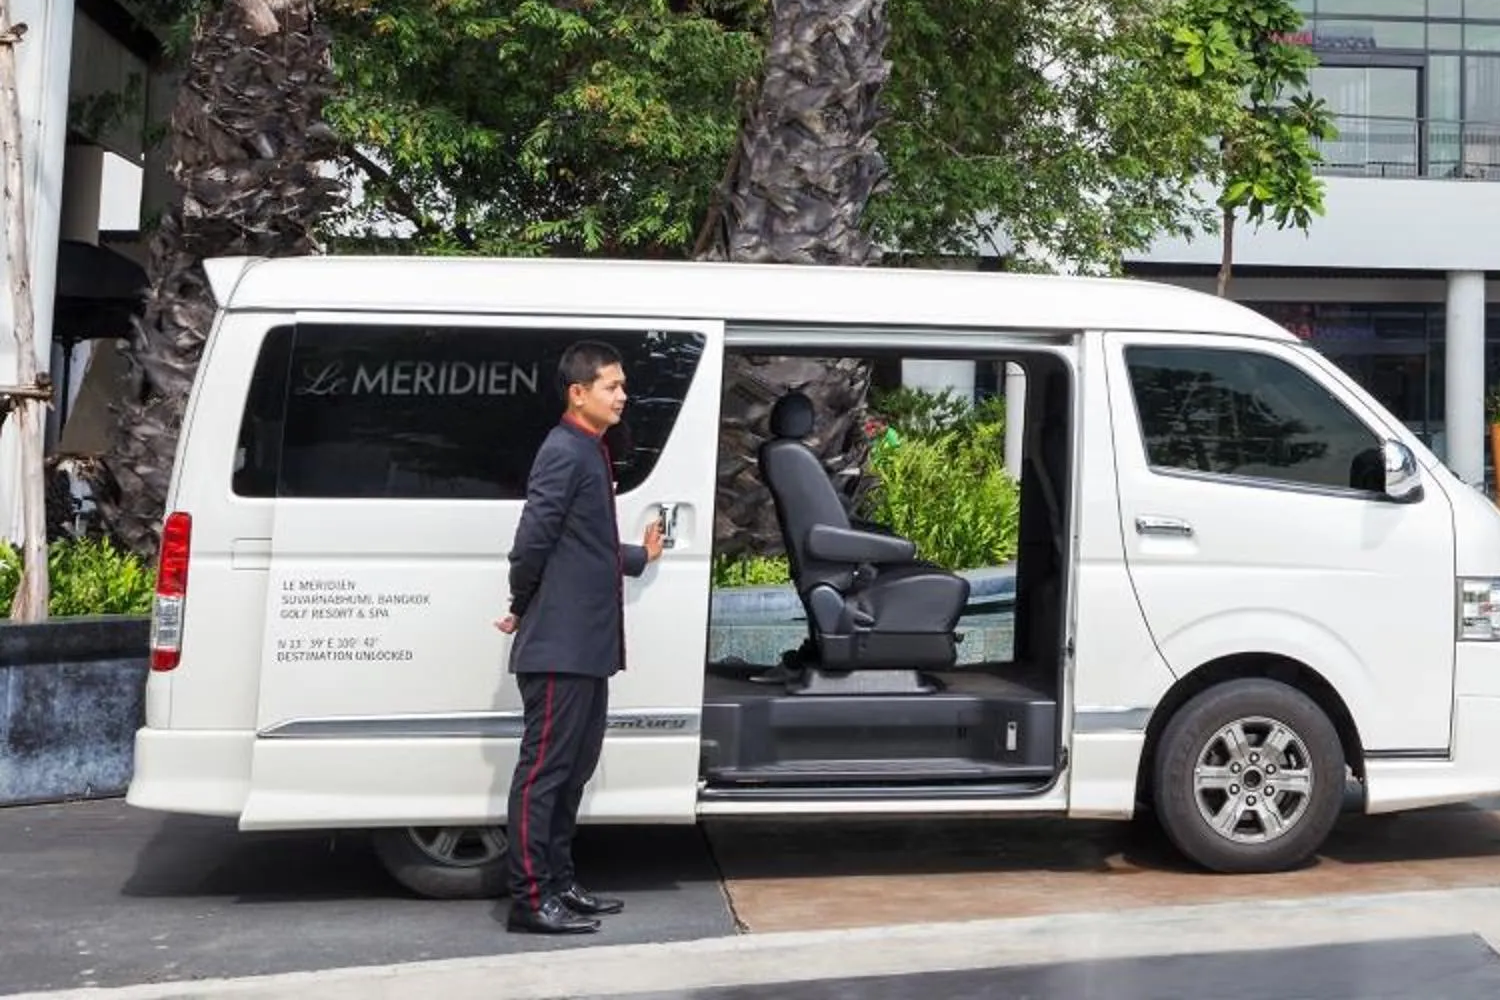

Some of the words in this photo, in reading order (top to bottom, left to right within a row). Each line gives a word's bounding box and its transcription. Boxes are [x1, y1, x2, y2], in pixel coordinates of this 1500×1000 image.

[296, 360, 348, 395] Le
[283, 580, 295, 591] LE
[280, 608, 307, 619] GOLF
[311, 608, 353, 619] RESORT
[356, 609, 365, 619] &
[277, 651, 352, 662] DESTINATION
[355, 650, 414, 662] UNLOCKED
